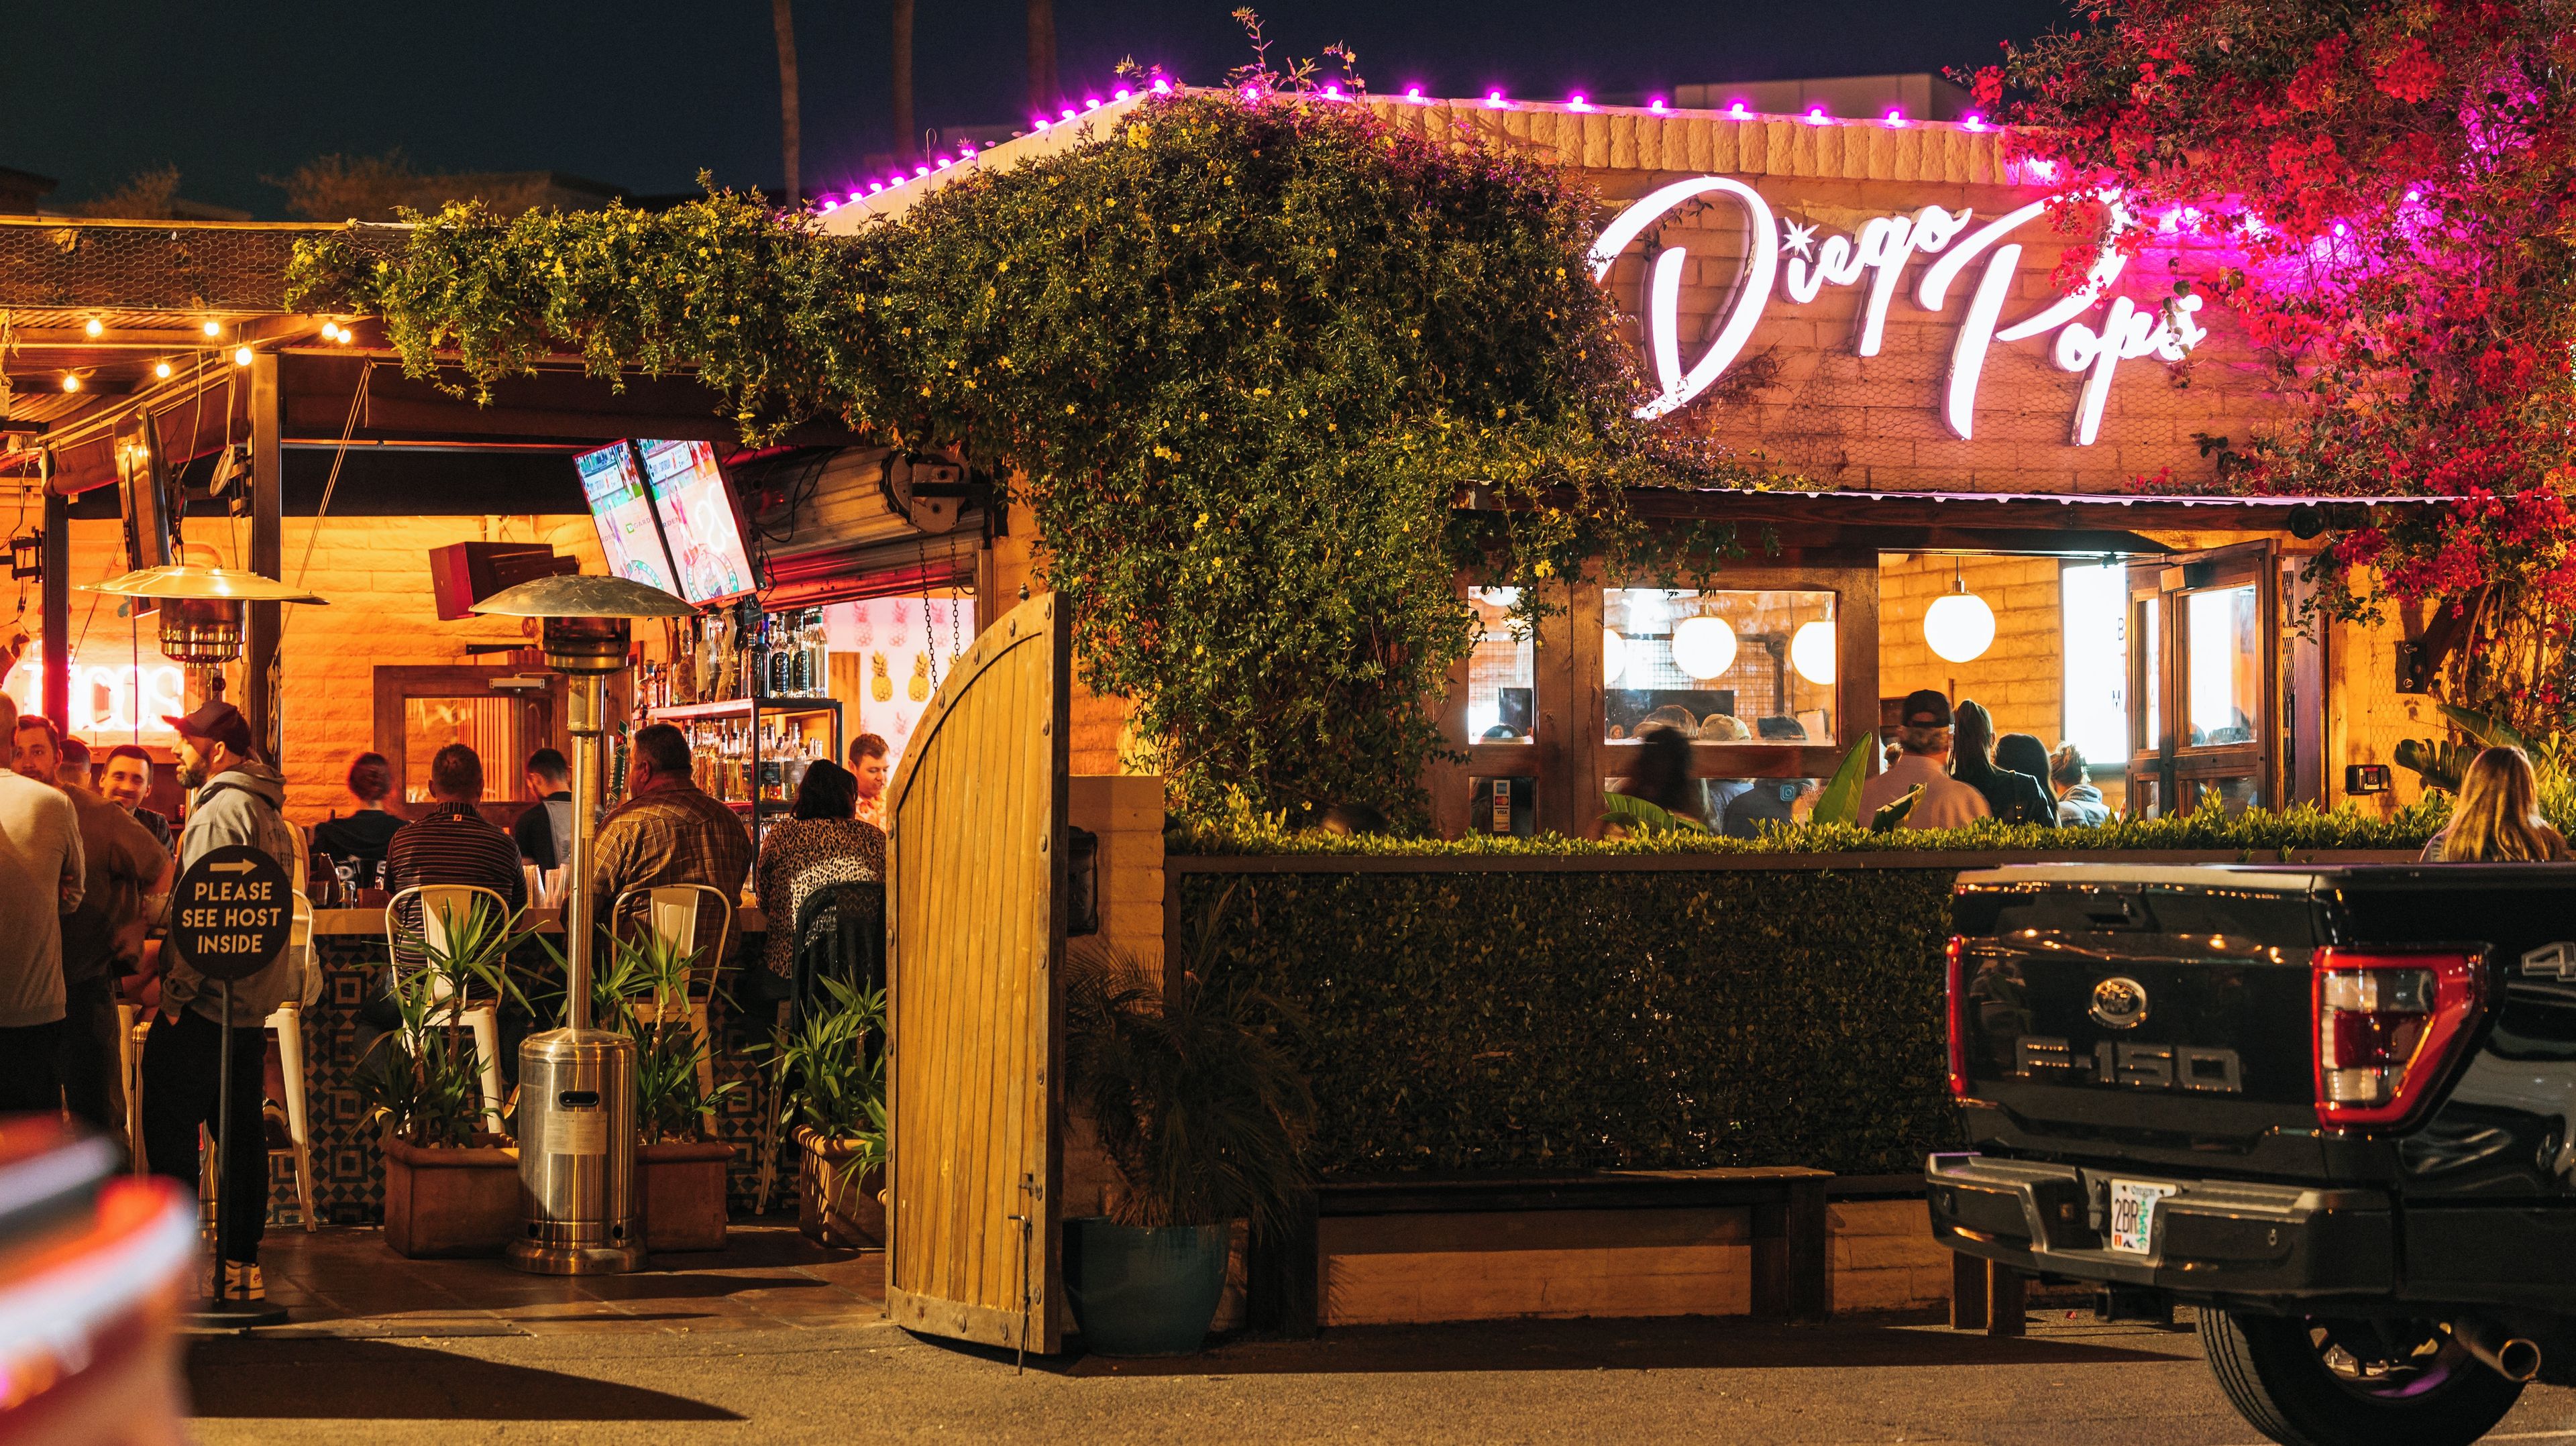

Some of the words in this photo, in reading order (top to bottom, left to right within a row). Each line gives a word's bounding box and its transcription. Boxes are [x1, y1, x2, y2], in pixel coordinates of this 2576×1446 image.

[1587, 176, 1974, 421] Diego
[1917, 186, 2208, 447] Pops
[21, 664, 185, 732] TCOS
[195, 882, 272, 901] PLEASE
[182, 908, 217, 928] SEE
[225, 907, 281, 927] HOST
[197, 934, 262, 954] INSIDE
[2015, 1036, 2243, 1093] F-150
